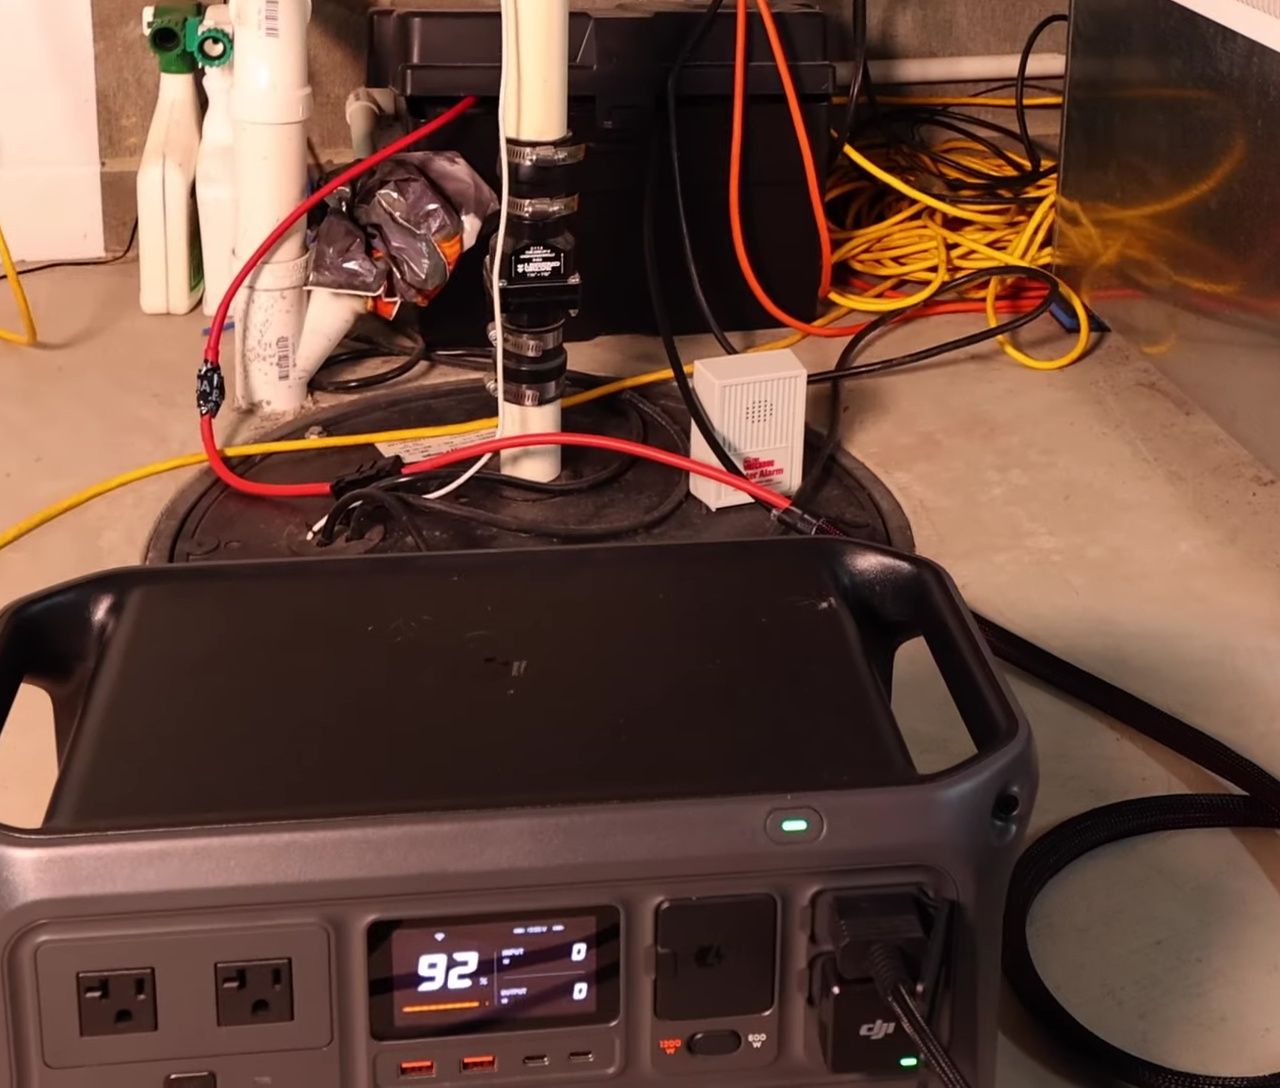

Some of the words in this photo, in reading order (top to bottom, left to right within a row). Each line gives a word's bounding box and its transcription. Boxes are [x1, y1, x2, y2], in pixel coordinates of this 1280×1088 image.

[571, 942, 587, 961] 0
[417, 951, 479, 992] 92
[572, 982, 588, 1000] 0
